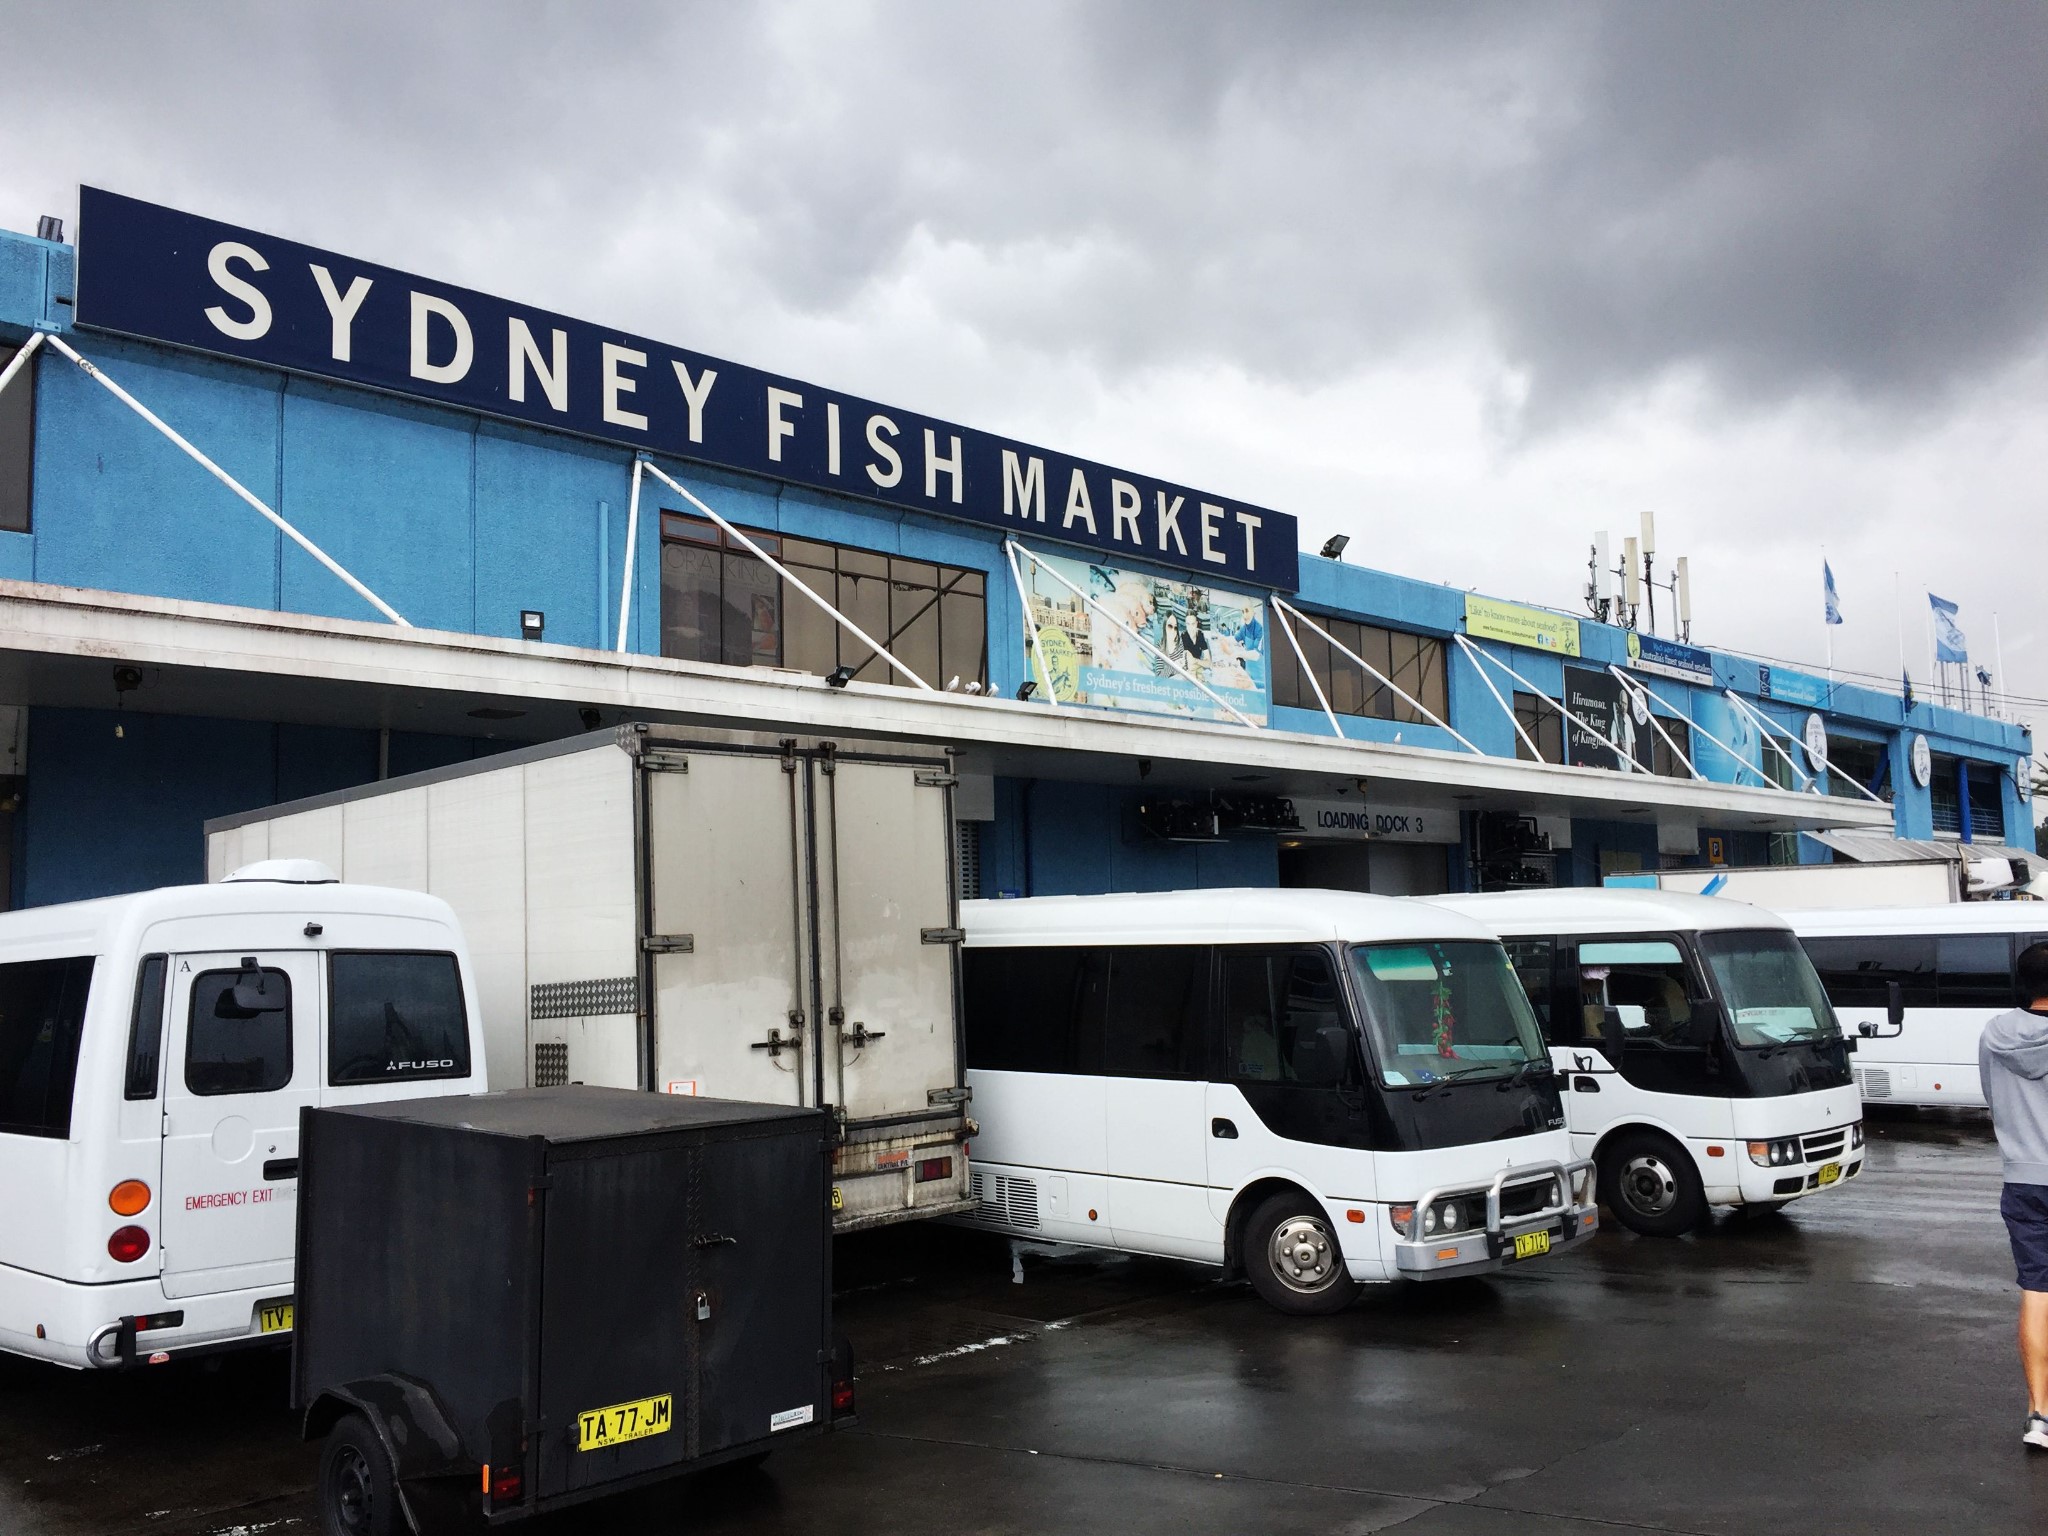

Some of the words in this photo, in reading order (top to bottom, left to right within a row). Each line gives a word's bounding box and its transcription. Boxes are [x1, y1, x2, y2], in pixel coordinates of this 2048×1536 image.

[205, 242, 718, 444] SYDNEY
[767, 387, 963, 504] FISH
[1003, 450, 1261, 571] MARKET
[725, 556, 771, 585] KING
[1490, 608, 1506, 621] know
[1506, 615, 1520, 625] more
[1521, 616, 1536, 628] about
[1041, 639, 1066, 648] SYDNEY
[1086, 672, 1131, 693] Sydney's
[1132, 678, 1171, 696] freshest
[1172, 685, 1209, 702] possible
[1575, 711, 1589, 725] The
[1590, 713, 1606, 732] King
[1572, 730, 1581, 747] of
[1317, 810, 1369, 831] LOADING
[1375, 814, 1410, 834] DOCK
[1416, 817, 1424, 833] 3
[180, 960, 192, 972] A
[398, 1059, 454, 1070] FUSO
[186, 1191, 248, 1211] EMERGENCY
[252, 1188, 274, 1203] EXIT
[597, 1437, 616, 1447] NSW
[624, 1427, 654, 1441] TRAILER
